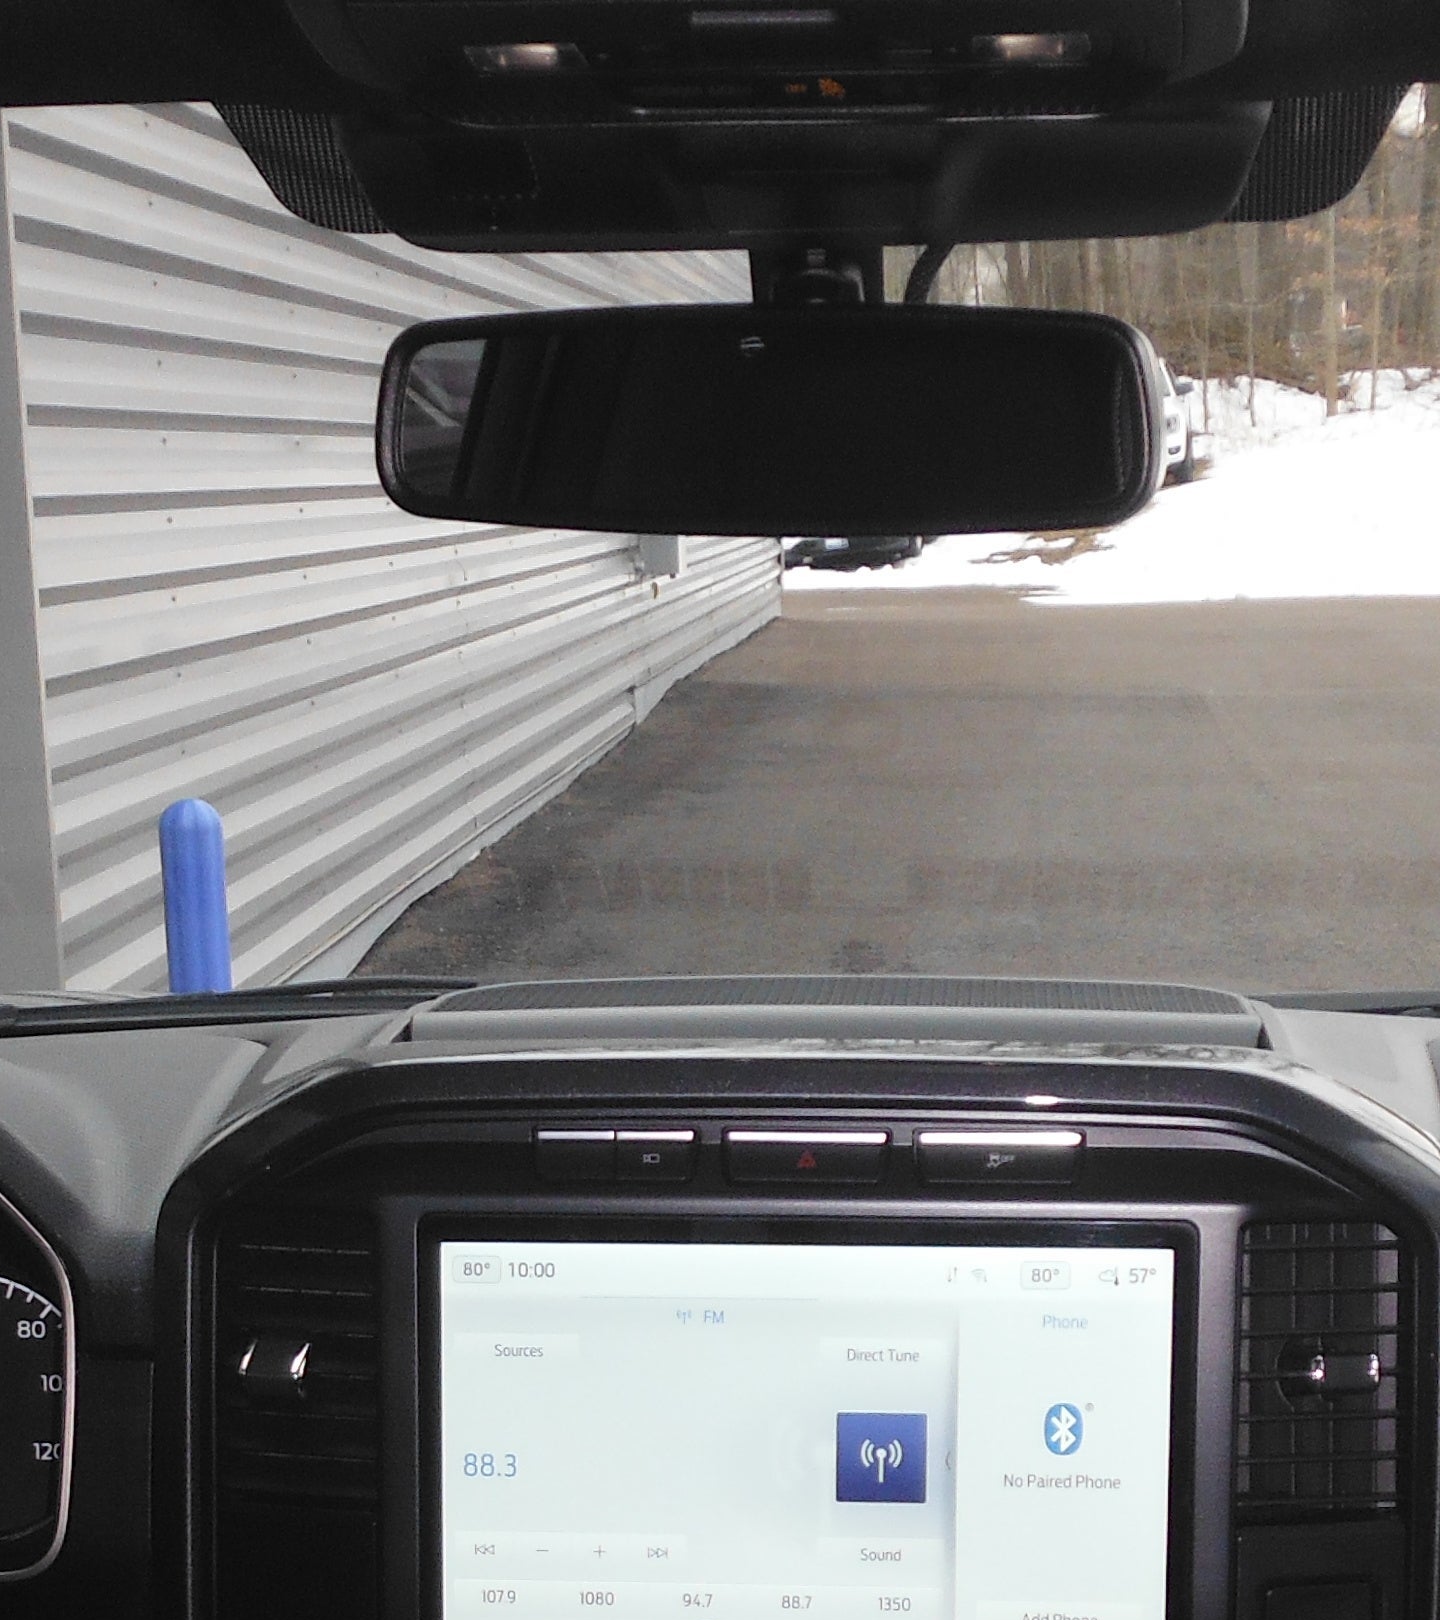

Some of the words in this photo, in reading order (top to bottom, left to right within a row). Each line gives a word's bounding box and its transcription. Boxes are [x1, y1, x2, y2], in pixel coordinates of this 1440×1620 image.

[507, 1261, 556, 1279] 10:00
[703, 1309, 726, 1325] FM
[1041, 1314, 1089, 1331] Phone
[16, 1319, 47, 1339] 80
[493, 1343, 545, 1358] Sources
[846, 1348, 884, 1363] Direct
[888, 1348, 921, 1363] Tune
[462, 1452, 519, 1480] 88.3
[1003, 1473, 1024, 1489] No
[1026, 1473, 1073, 1490] Paired
[1075, 1474, 1122, 1490] Phone
[859, 1547, 903, 1563] Sound
[579, 1591, 616, 1606] 1080
[681, 1592, 714, 1609] 94.7
[780, 1594, 813, 1610] 88.7
[877, 1596, 912, 1612] 1350
